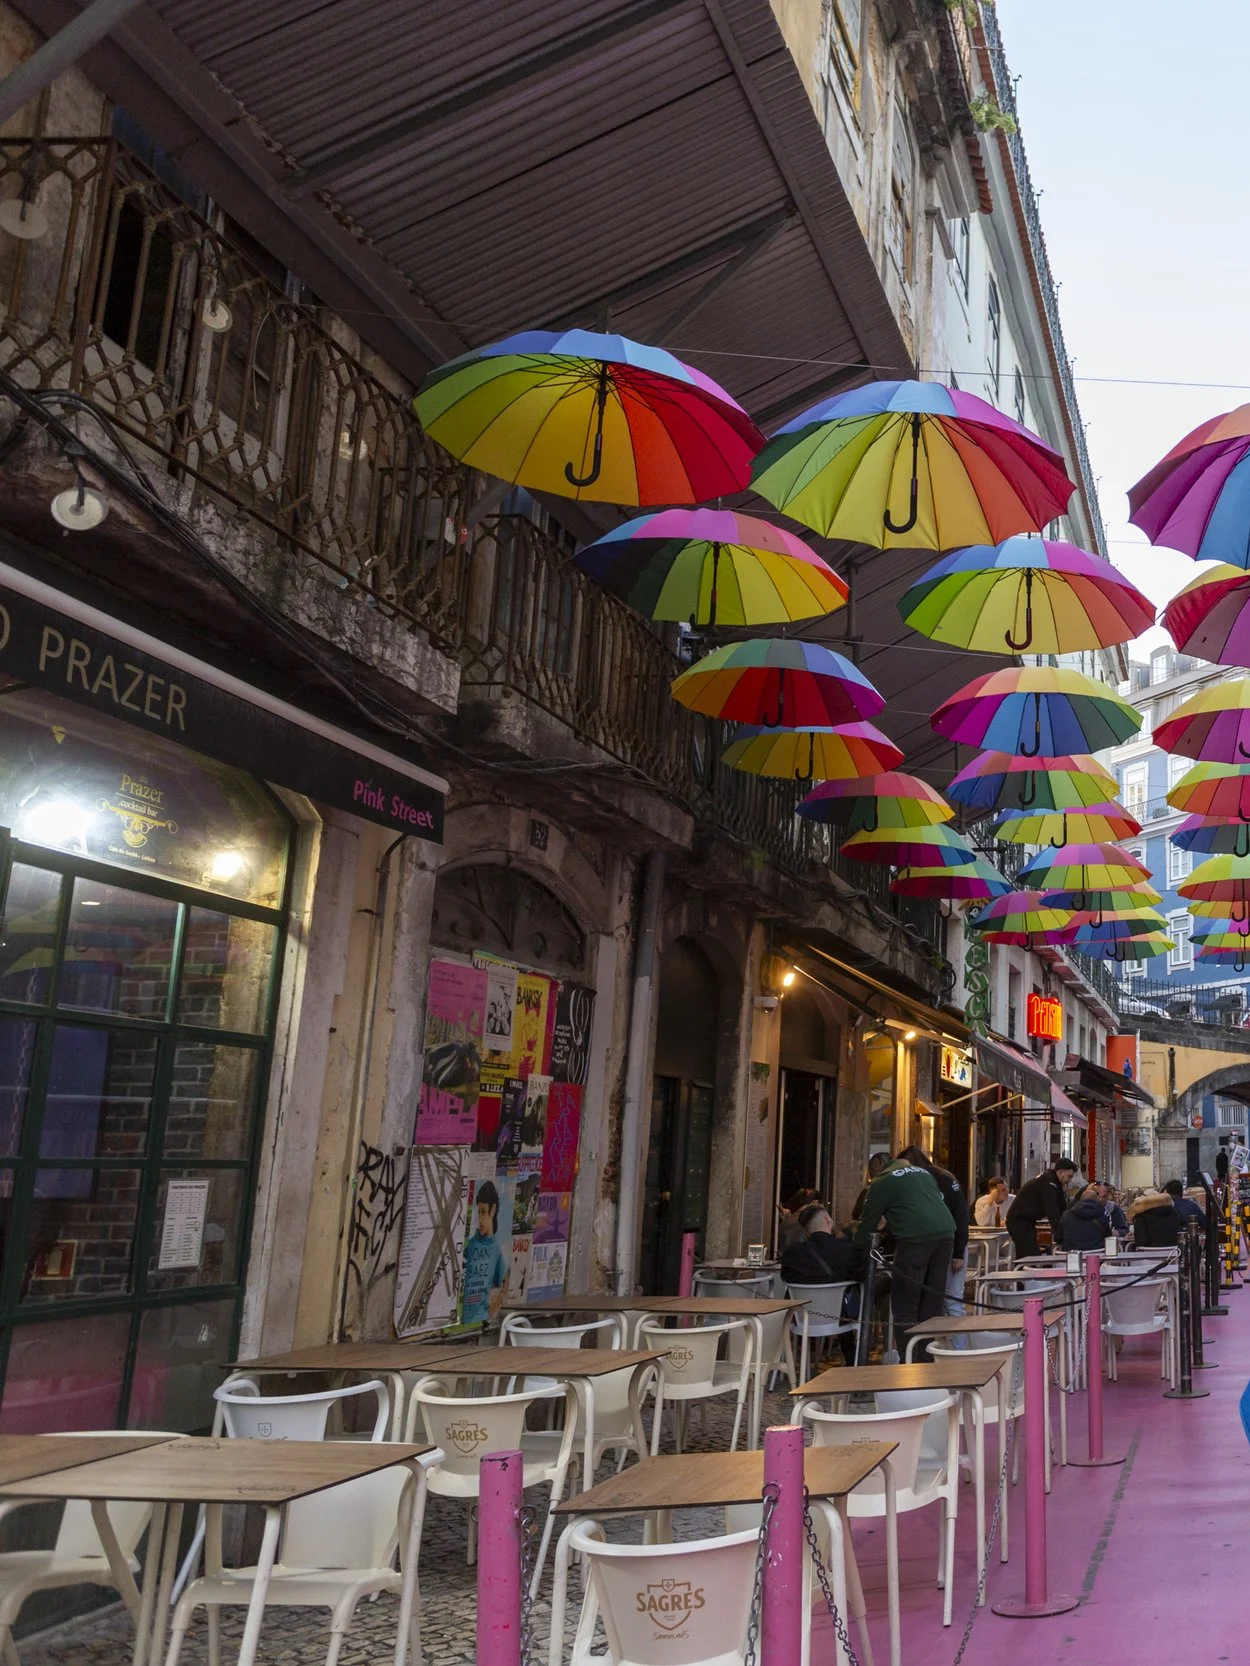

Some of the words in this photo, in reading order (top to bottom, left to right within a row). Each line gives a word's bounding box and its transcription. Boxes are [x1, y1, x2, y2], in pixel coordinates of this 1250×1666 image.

[38, 626, 188, 731] PRAZER
[119, 772, 165, 803] Prazer
[353, 779, 386, 812] Pink
[390, 795, 435, 829] Street
[516, 985, 543, 1006] BANKSY
[666, 1350, 694, 1361] AGRES
[445, 1427, 489, 1441] SAGRES
[636, 1587, 706, 1612] SAGRES
